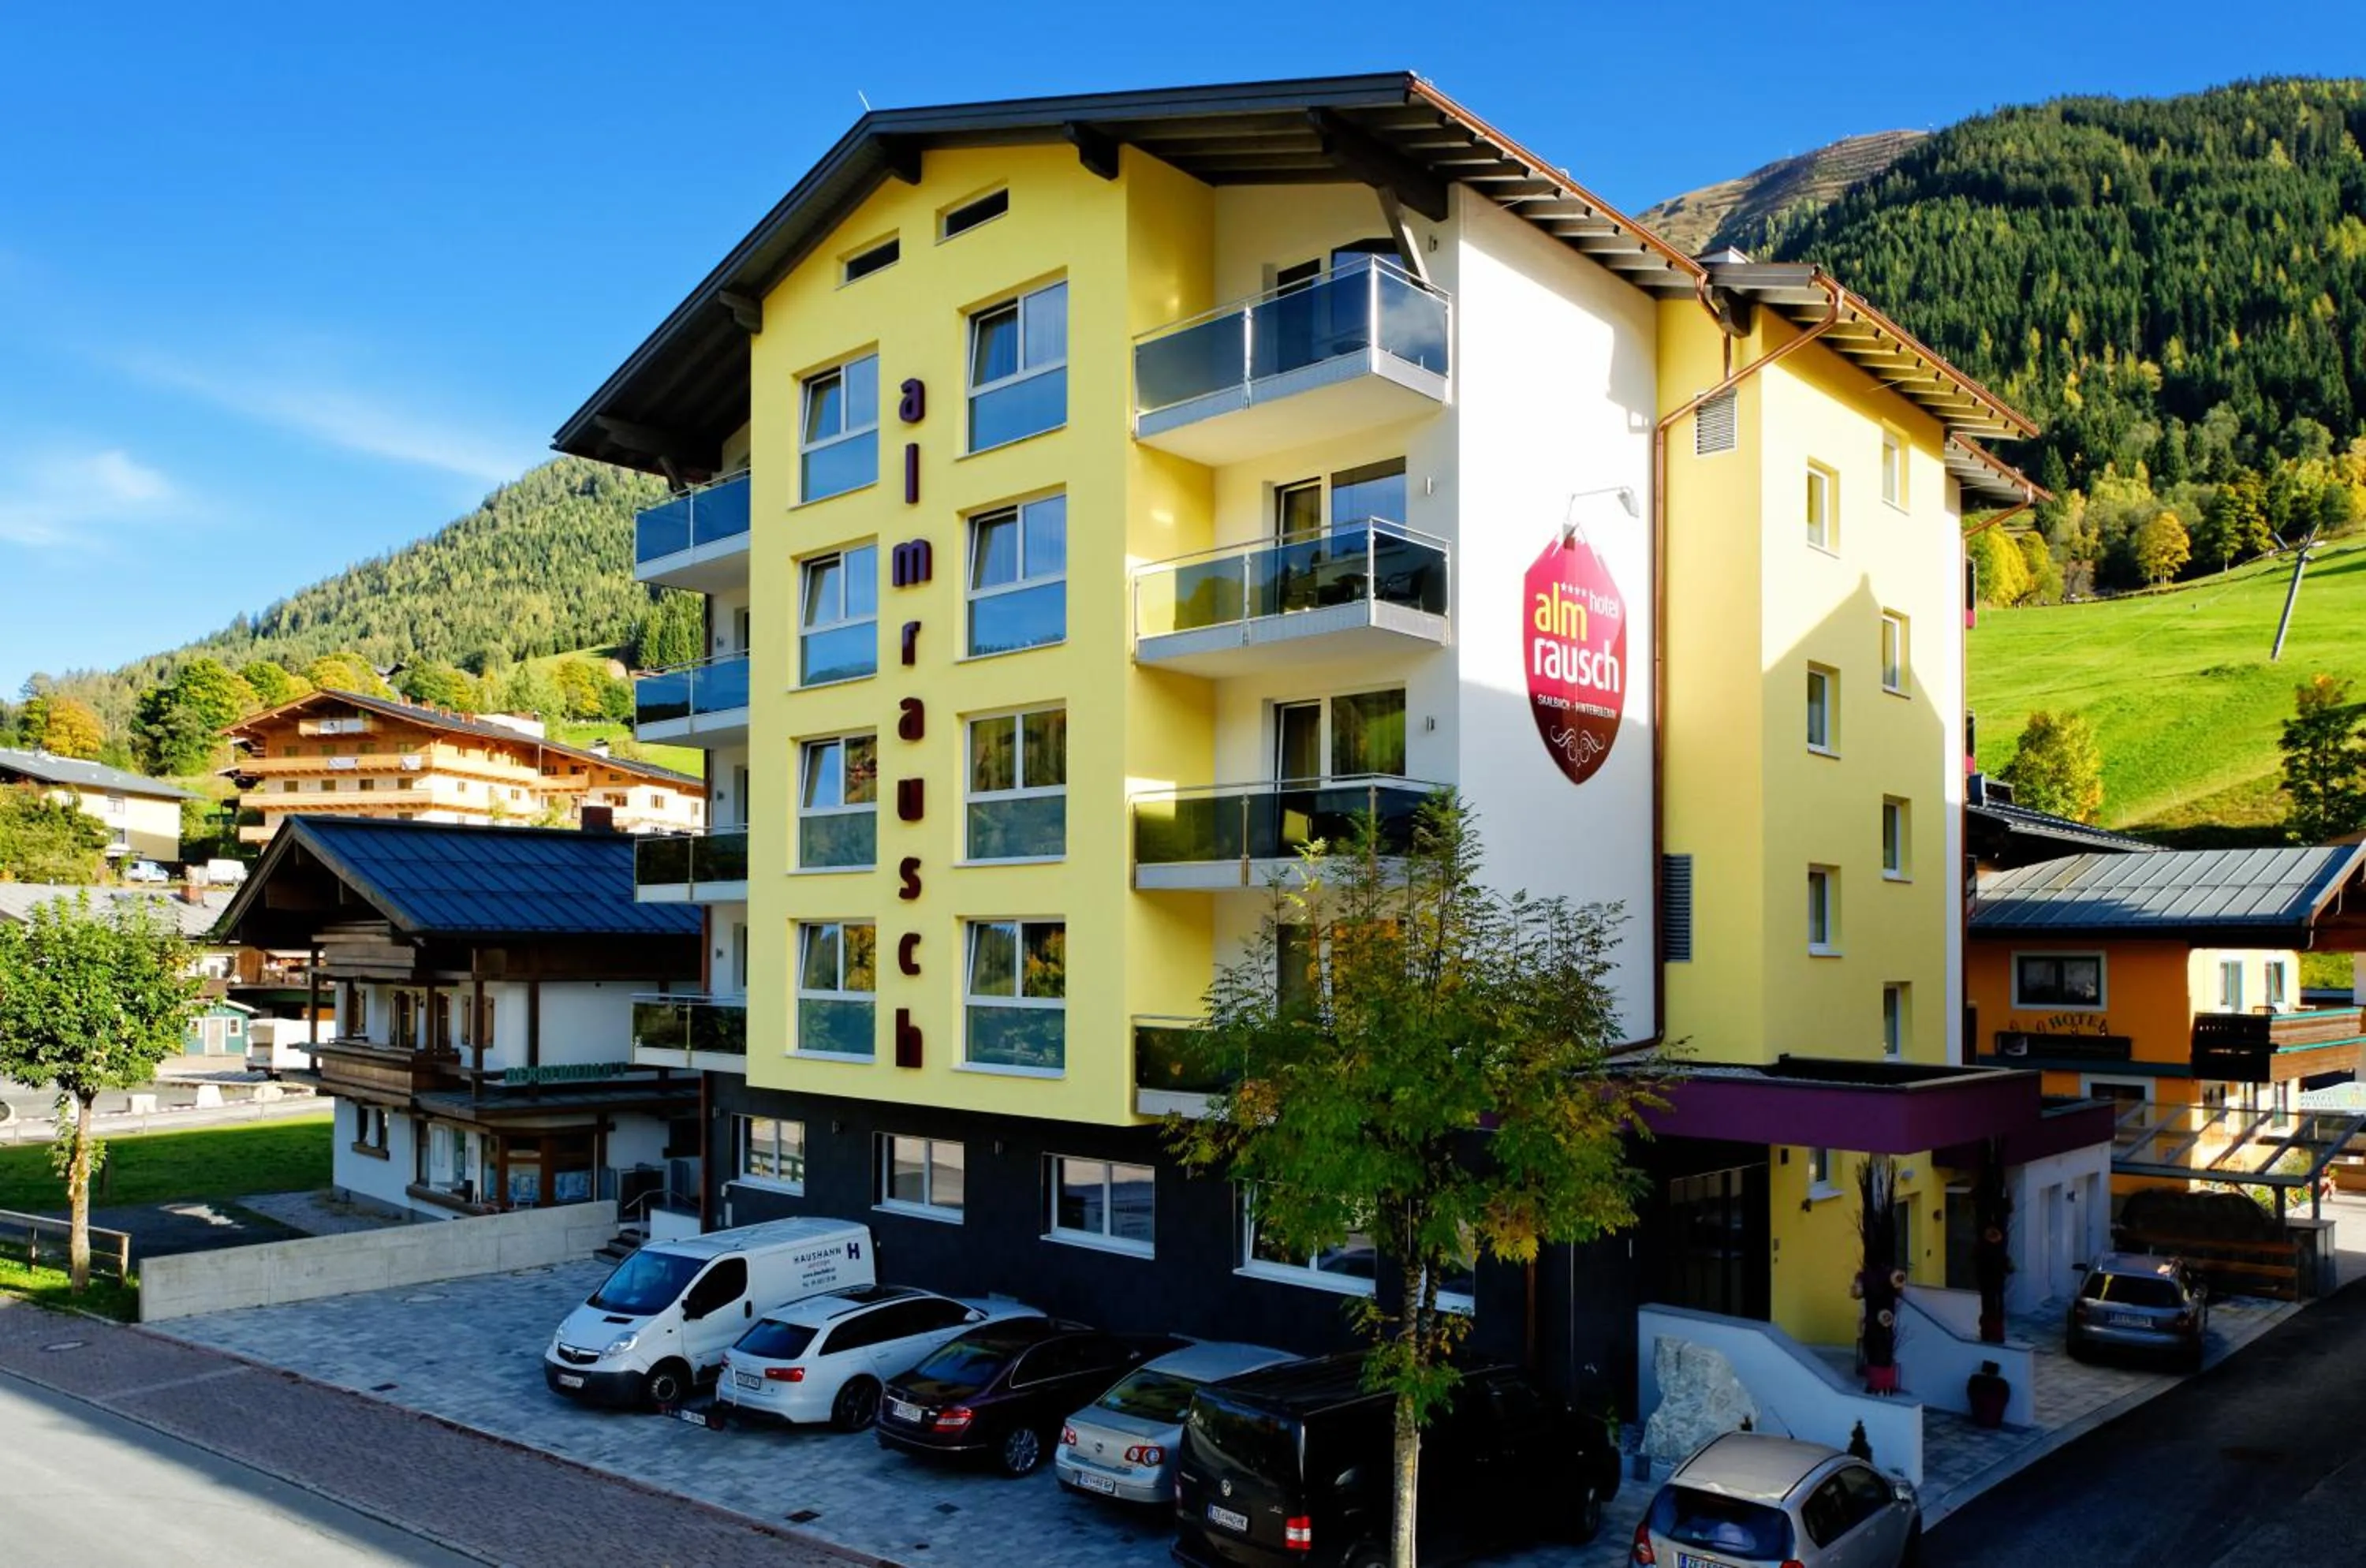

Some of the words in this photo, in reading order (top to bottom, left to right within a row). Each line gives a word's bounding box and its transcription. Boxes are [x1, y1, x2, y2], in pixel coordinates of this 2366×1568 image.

[1534, 581, 1588, 641] alm
[1589, 590, 1619, 619] hotel
[1534, 637, 1619, 693] rausch
[846, 1242, 860, 1260] H
